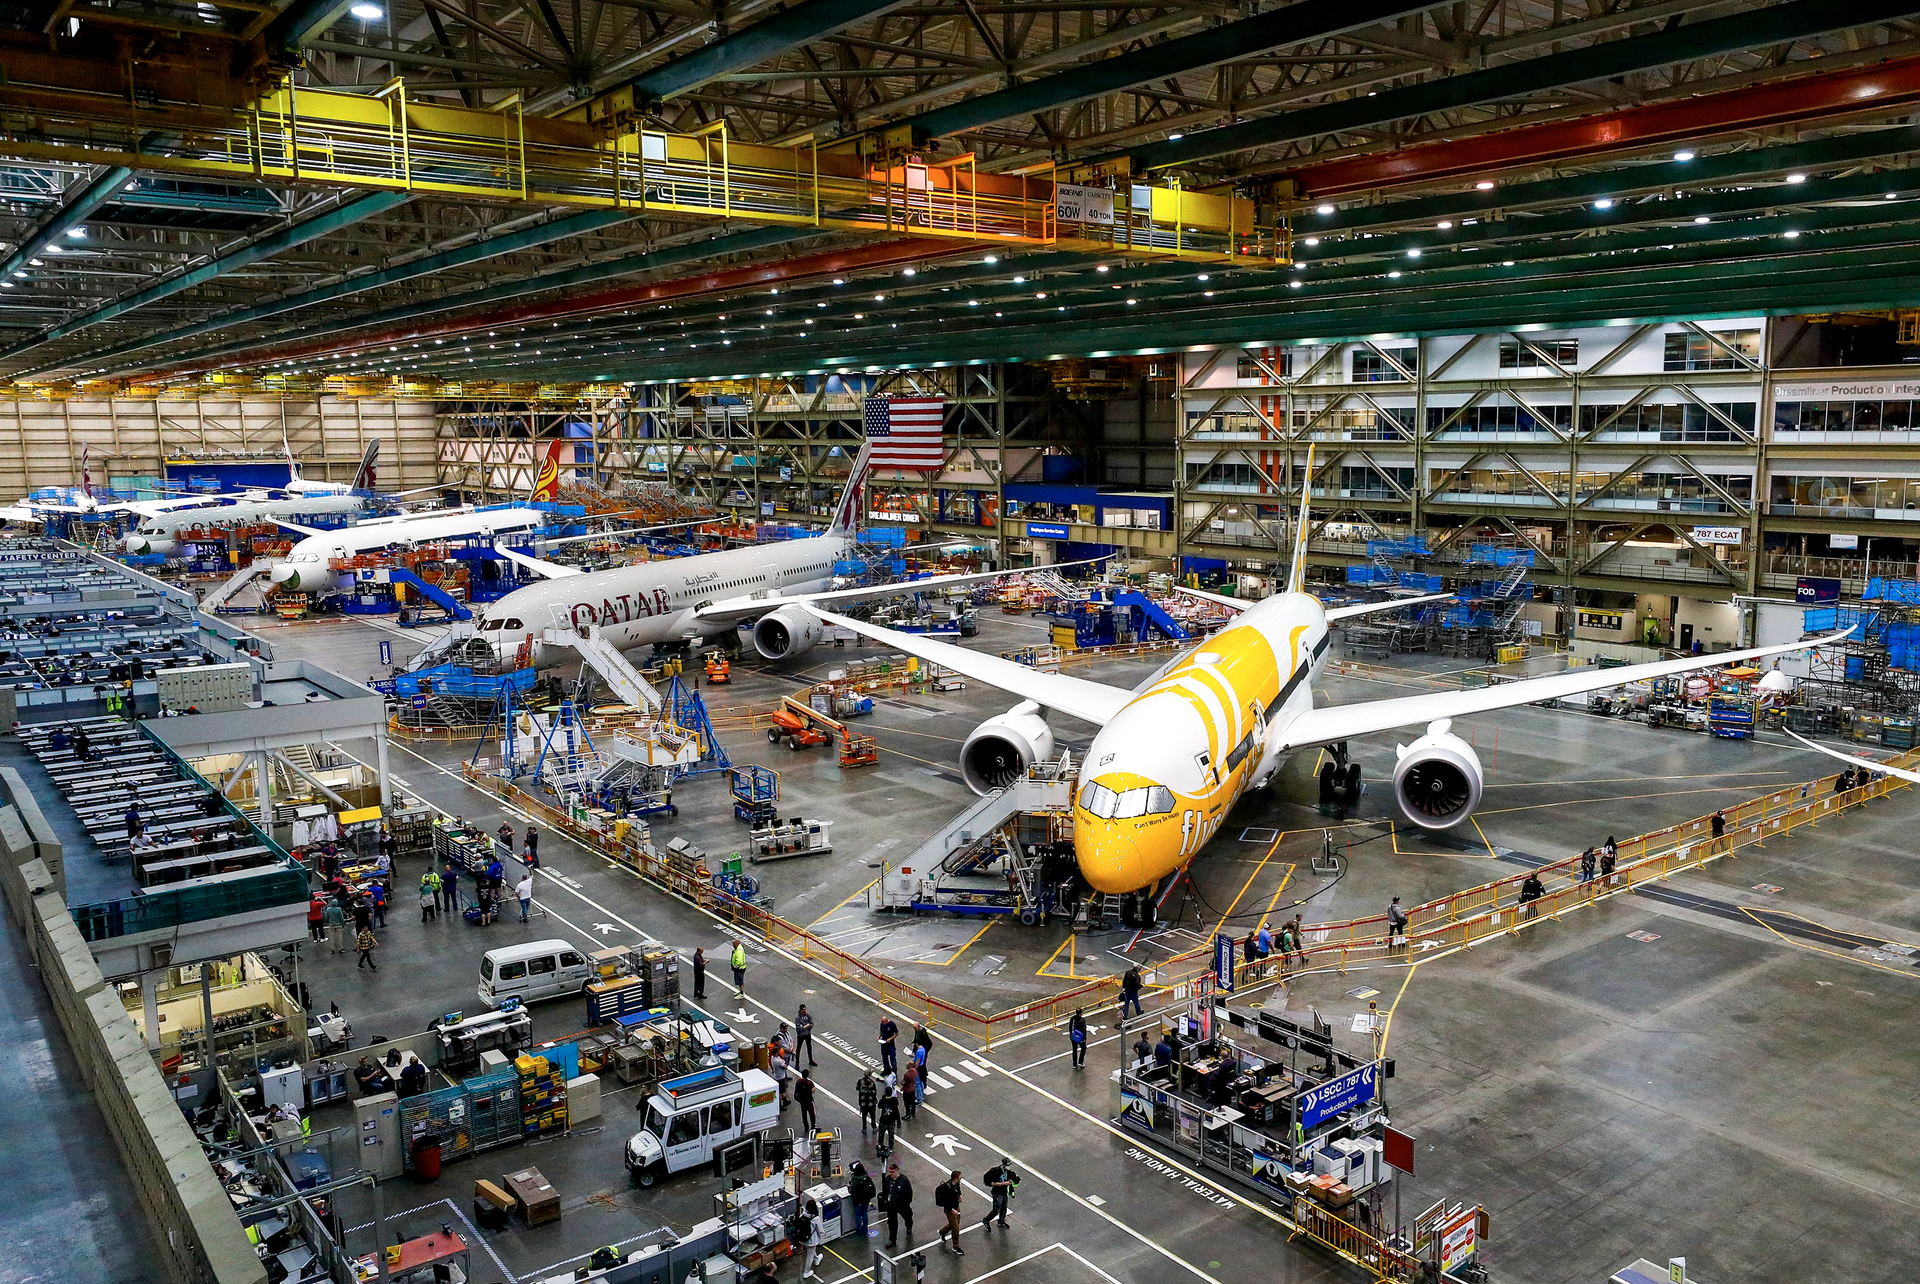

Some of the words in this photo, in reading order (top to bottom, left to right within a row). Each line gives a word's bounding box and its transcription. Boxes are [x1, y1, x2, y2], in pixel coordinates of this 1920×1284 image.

[1059, 188, 1083, 197] BOEING
[1058, 205, 1081, 219] 60W
[1089, 209, 1098, 219] 40
[1099, 212, 1111, 220] TON
[1774, 386, 1829, 397] Dreamliner
[1831, 384, 1890, 395] Production
[1696, 530, 1711, 538] 787
[1714, 531, 1739, 539] ECAT
[4, 553, 39, 562] SAFETY
[40, 552, 76, 560] CENTER
[1797, 587, 1816, 596] FOD
[571, 588, 671, 631] QATAR
[820, 1031, 857, 1053] MATERIAL
[1318, 1081, 1343, 1101] LSCC
[1346, 1073, 1360, 1088] 787
[1320, 1100, 1348, 1118] Production
[1124, 1148, 1181, 1180] HANDLING
[1180, 1176, 1237, 1210] MATERIAL
